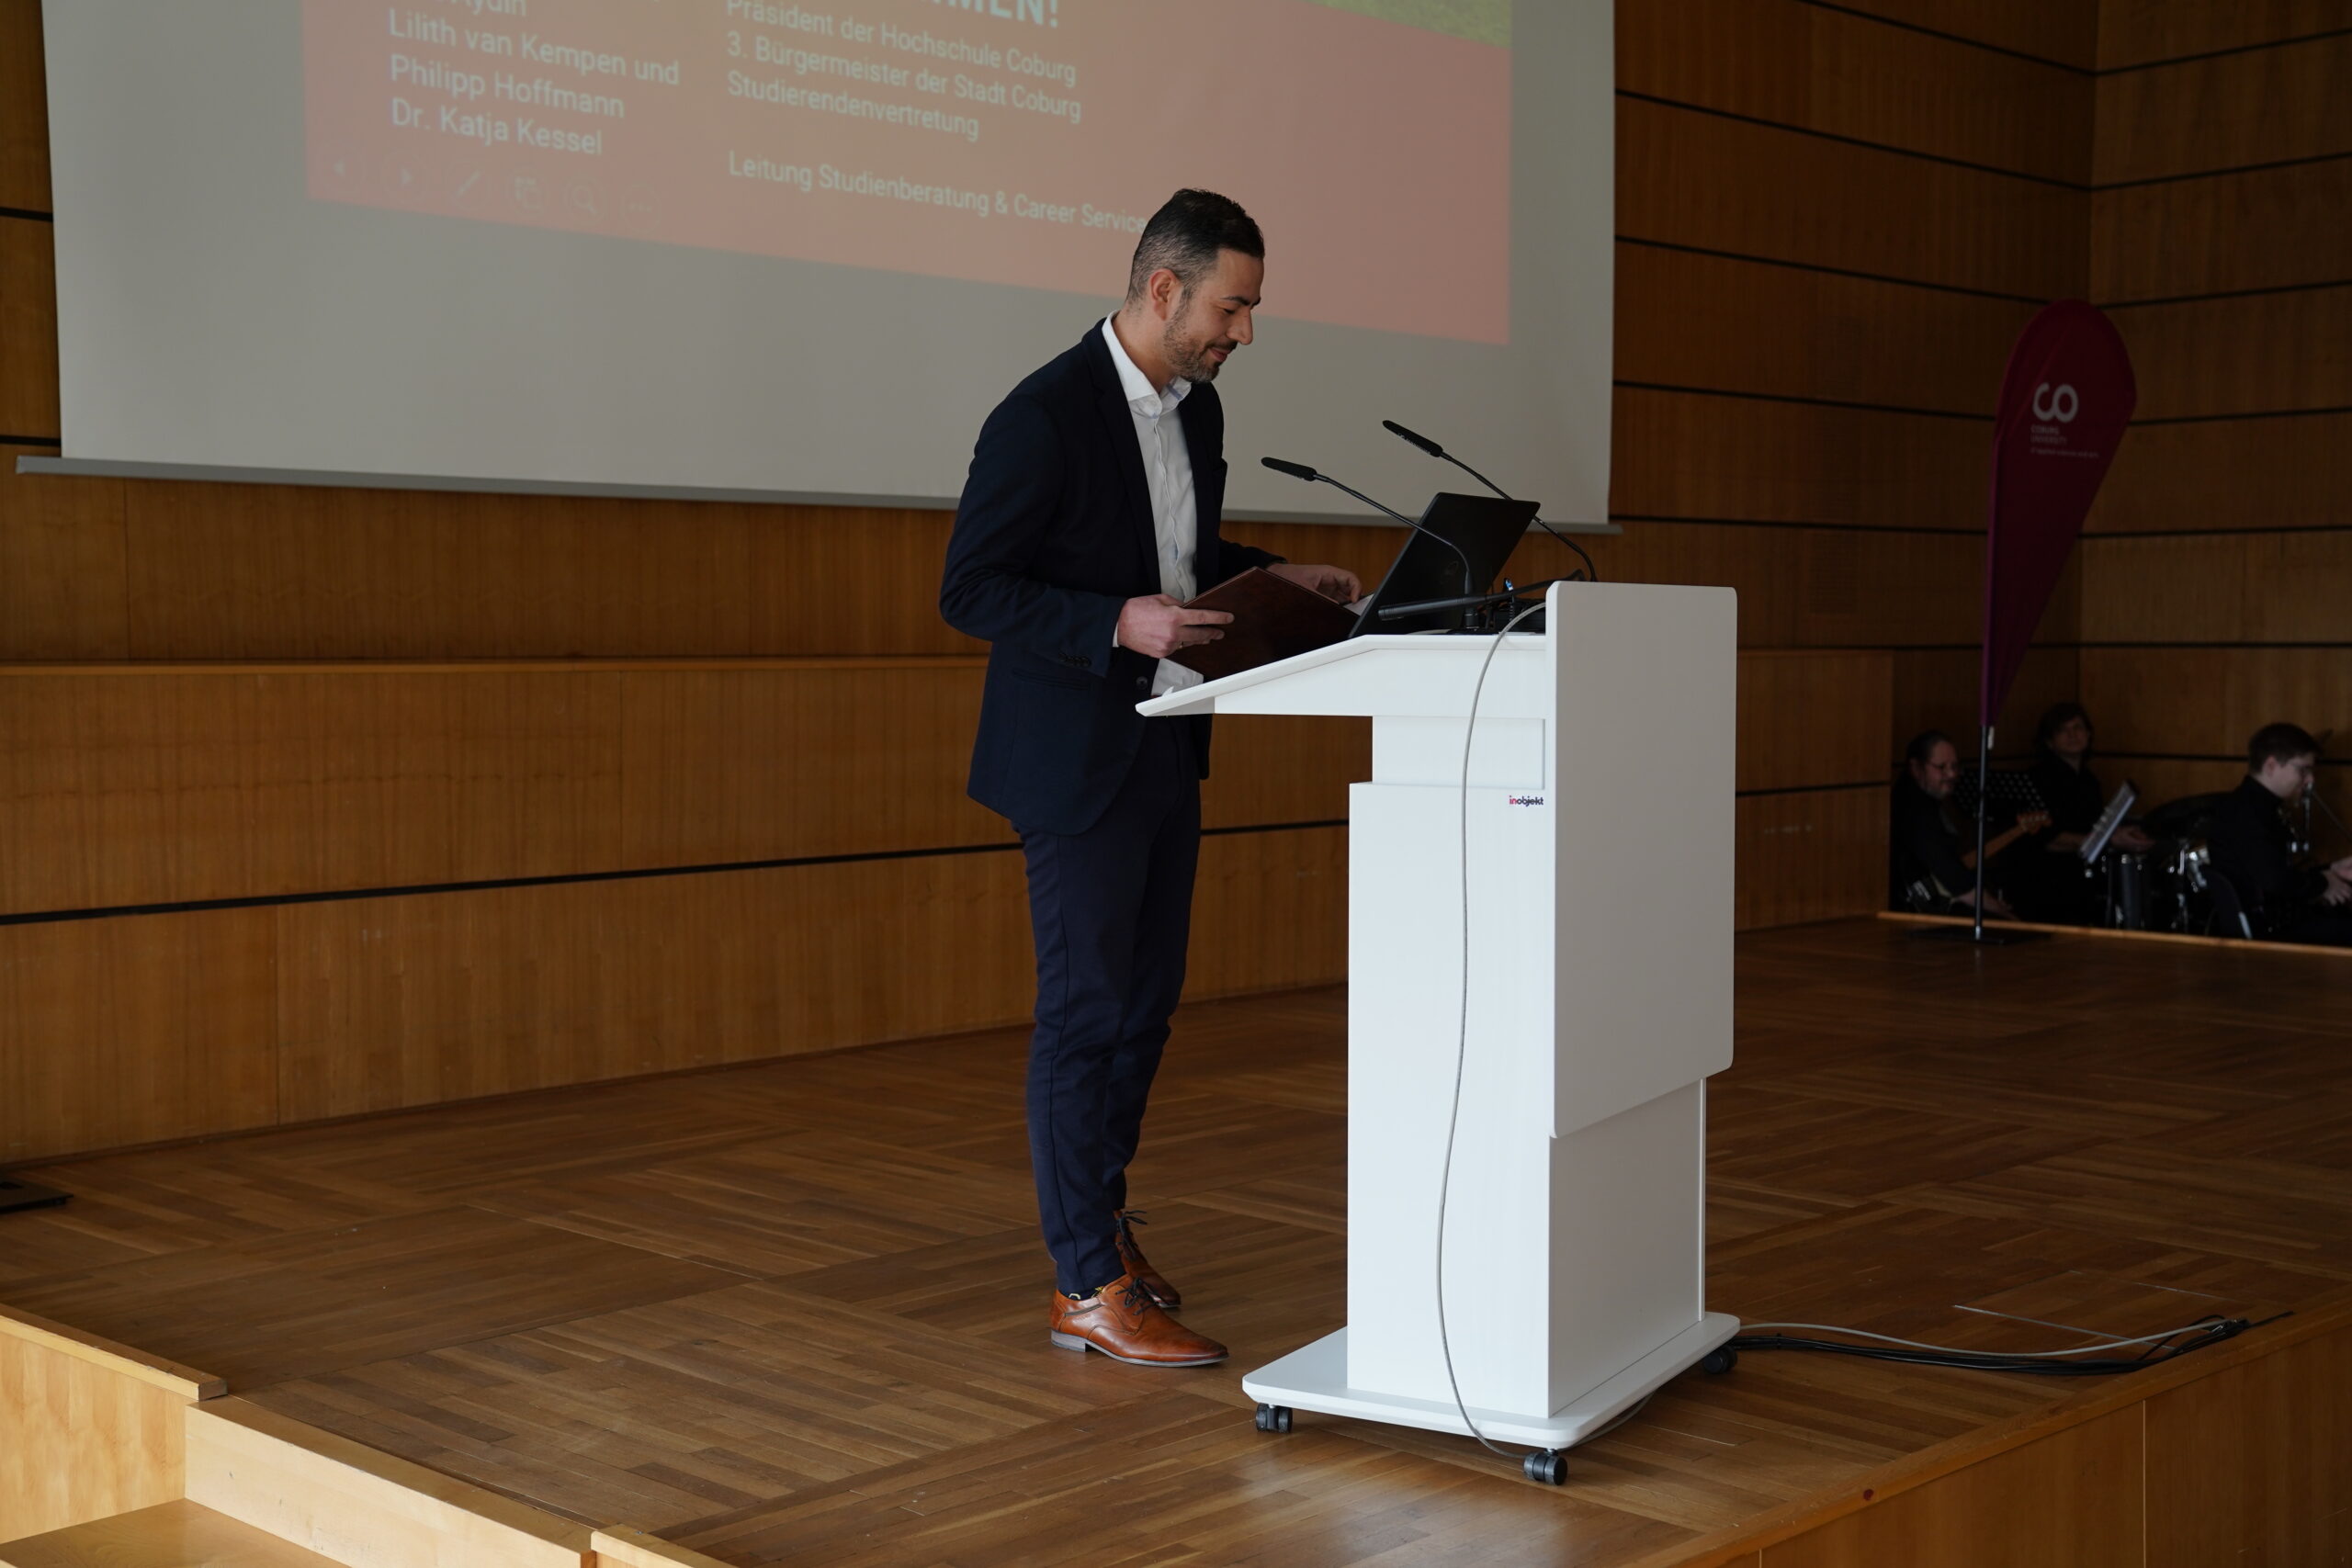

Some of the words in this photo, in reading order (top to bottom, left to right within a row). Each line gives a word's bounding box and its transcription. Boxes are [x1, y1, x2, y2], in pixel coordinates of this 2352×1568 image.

[389, 7, 457, 47] Lilith
[465, 29, 512, 56] van
[522, 33, 626, 76] Kempen
[634, 60, 680, 85] und
[727, 0, 832, 36] Präsident
[841, 17, 874, 43] der
[880, 22, 1001, 69] Hochschule
[1007, 48, 1077, 88] Coburg
[727, 31, 748, 58] 3.
[755, 36, 909, 87] Bürgermeister
[915, 69, 947, 94] der
[955, 74, 1006, 106] Stadt
[1012, 85, 1082, 124] Coburg
[390, 53, 485, 99] Philipp
[494, 73, 625, 118] Hoffmann
[727, 70, 978, 142] Studierendenvertretung
[391, 96, 432, 130] Dr.
[440, 106, 509, 147] Katja
[517, 118, 603, 155] Kessel
[729, 151, 812, 192] Leitung
[820, 164, 989, 218] Studienberatung
[995, 191, 1009, 215] &
[1013, 194, 1077, 224] Career
[1509, 795, 1544, 807] inobjekt
